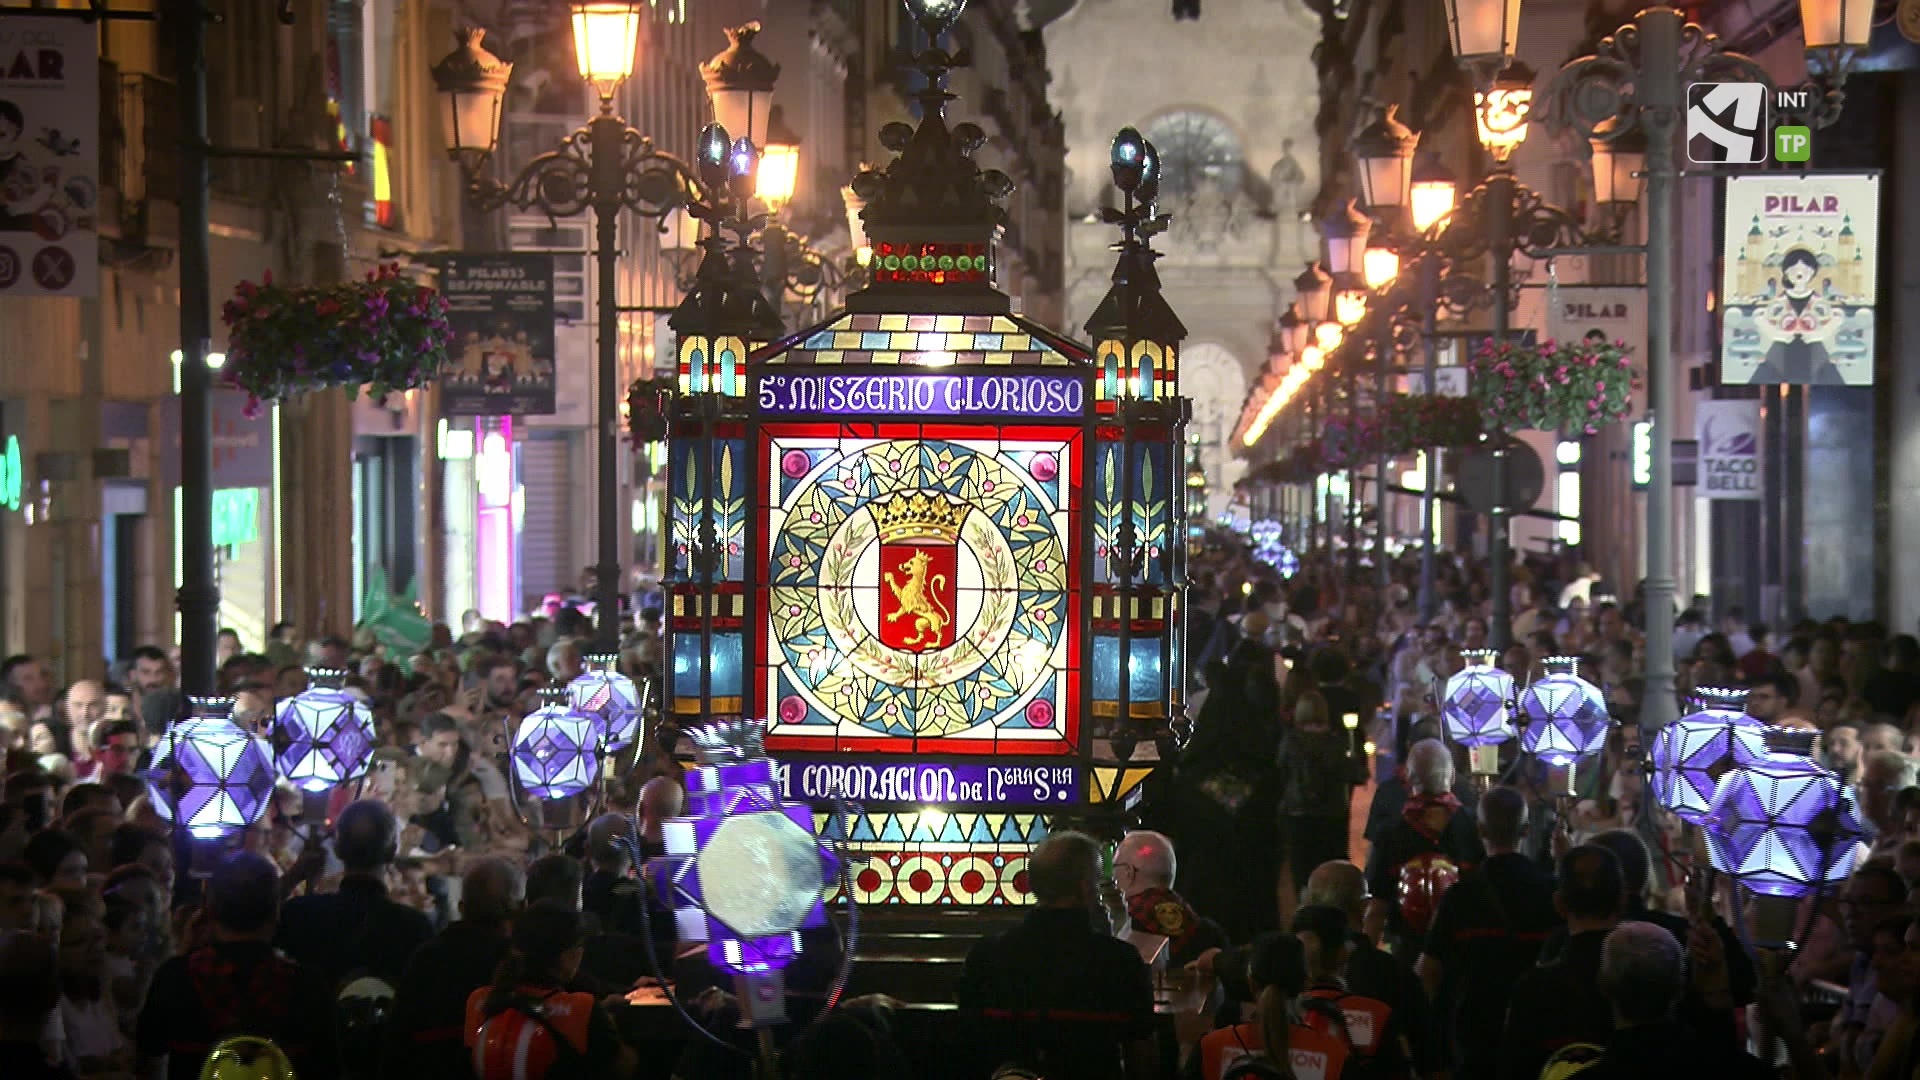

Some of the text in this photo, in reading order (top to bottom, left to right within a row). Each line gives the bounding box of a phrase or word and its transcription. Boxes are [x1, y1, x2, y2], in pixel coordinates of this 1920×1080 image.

[1764, 195, 1838, 213] PILAR
[1563, 303, 1627, 317] PILAR
[789, 376, 935, 410] MISTERIO
[944, 376, 1083, 413] GLORIOSO
[1704, 458, 1757, 474] TACO
[1707, 475, 1756, 490] BELL
